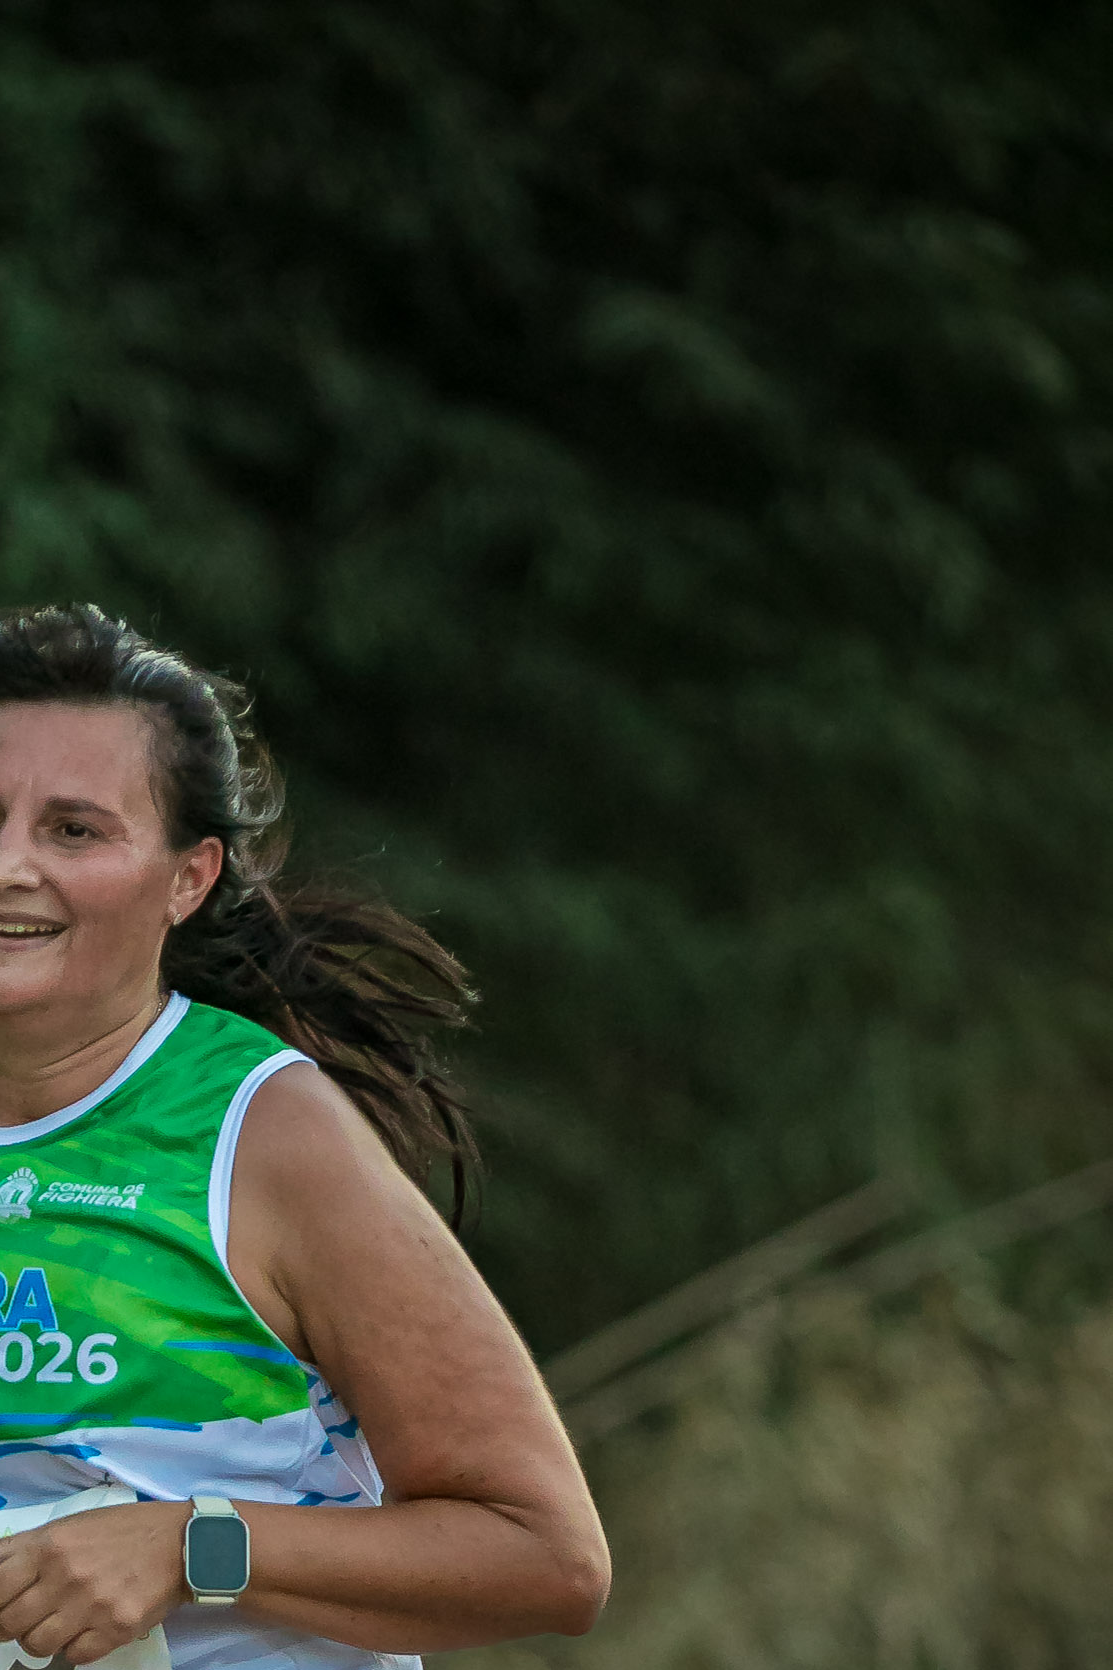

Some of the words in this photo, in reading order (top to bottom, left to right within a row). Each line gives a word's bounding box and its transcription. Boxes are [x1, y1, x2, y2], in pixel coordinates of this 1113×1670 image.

[48, 1181, 119, 1195] COMUNA
[122, 1183, 146, 1196] DE
[38, 1190, 137, 1210] FIGHIERA
